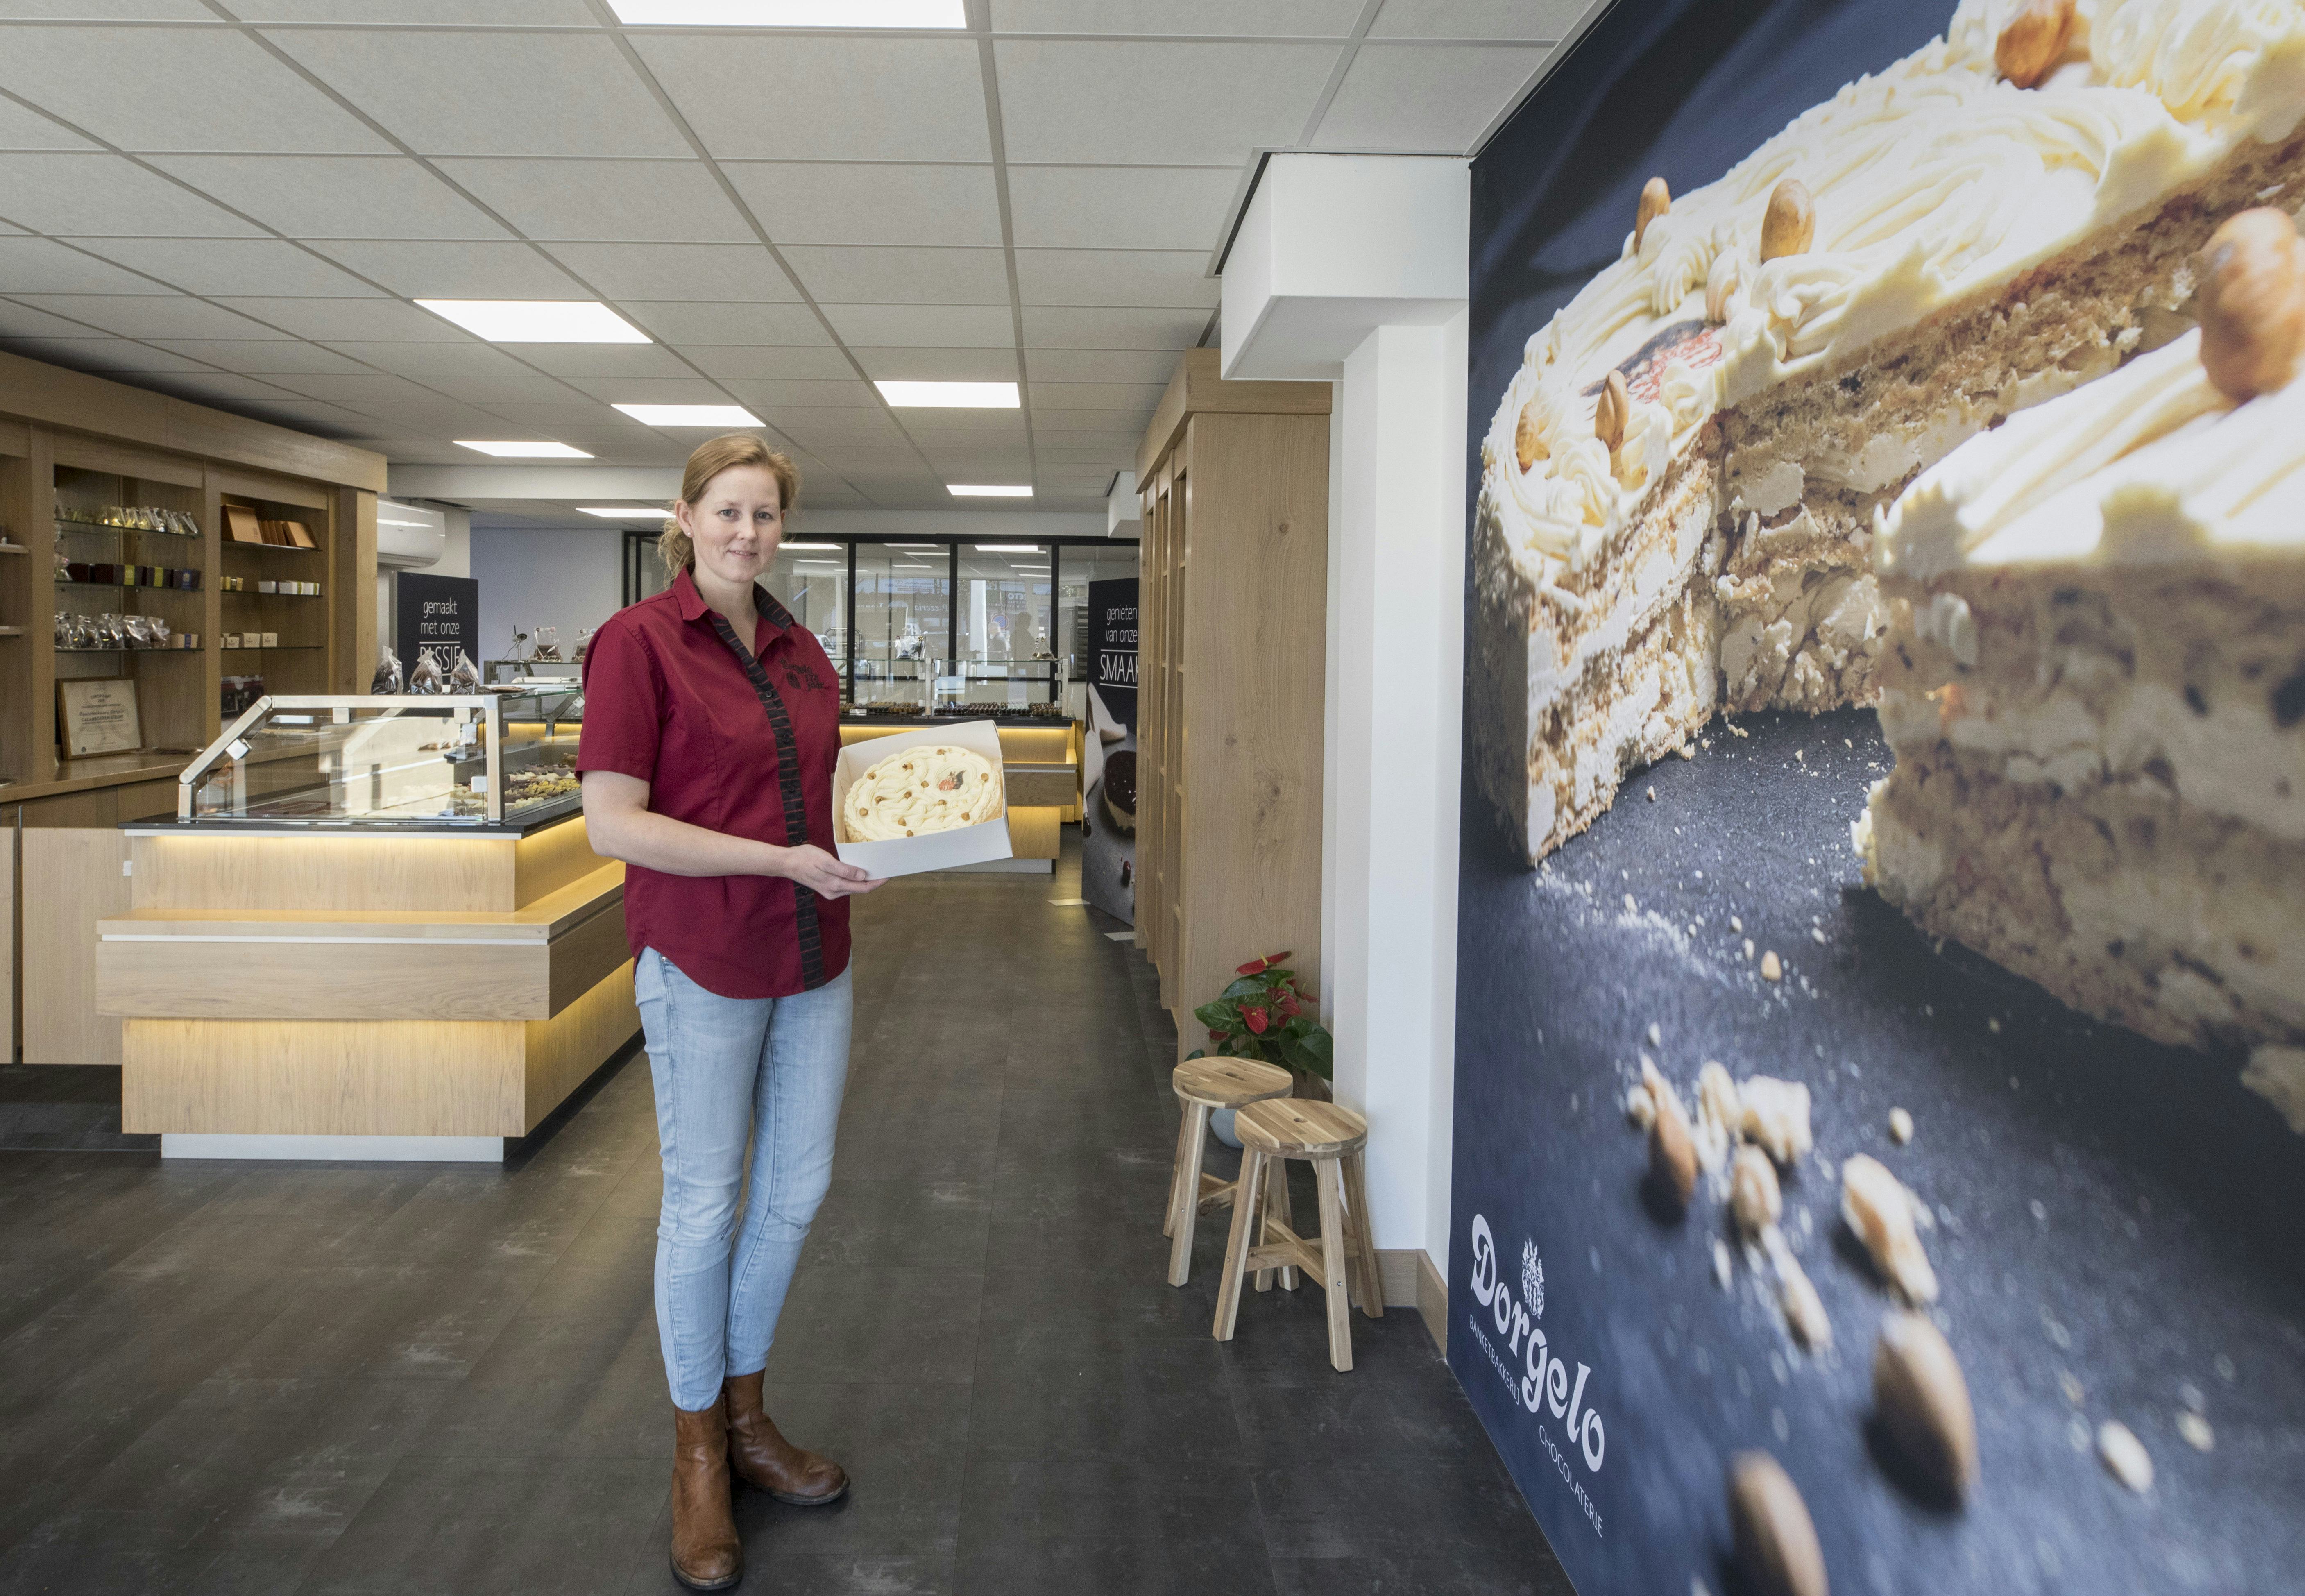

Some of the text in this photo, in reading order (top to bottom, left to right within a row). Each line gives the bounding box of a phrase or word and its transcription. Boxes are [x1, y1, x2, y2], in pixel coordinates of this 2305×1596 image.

[423, 597, 457, 618] gemaakt
[1106, 604, 1137, 626] genieten
[421, 620, 460, 635] met onze
[1106, 630, 1138, 642] van onze
[1471, 1214, 1605, 1472] Dorgelo
[1470, 1314, 1602, 1538] BANKETBAKKERIJ CHOCOLATERIE
